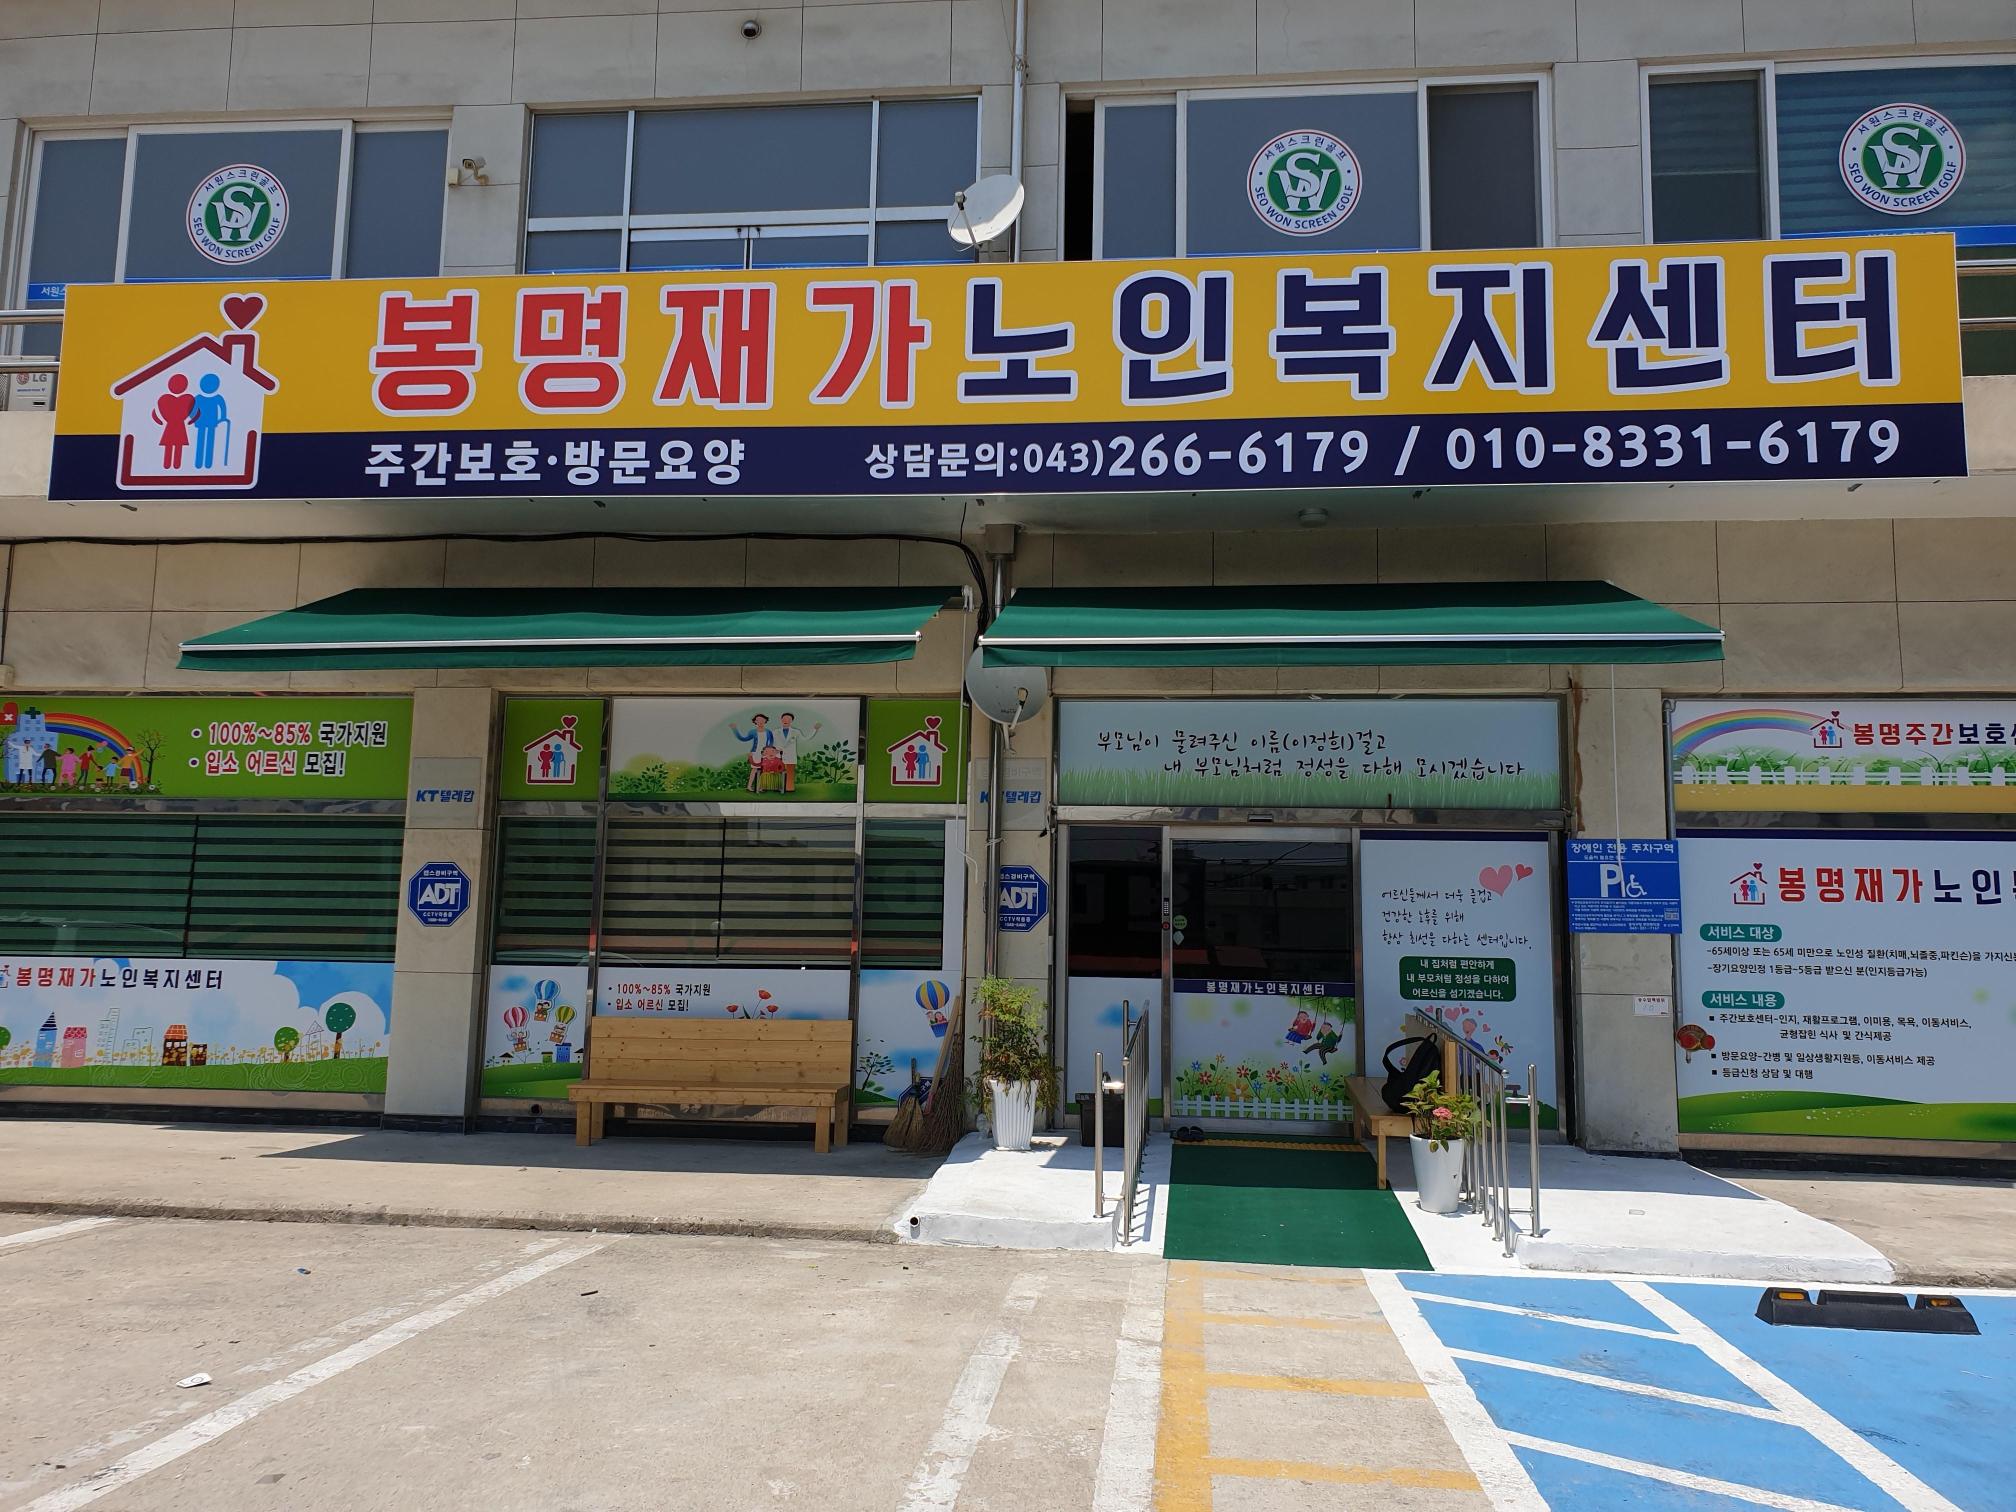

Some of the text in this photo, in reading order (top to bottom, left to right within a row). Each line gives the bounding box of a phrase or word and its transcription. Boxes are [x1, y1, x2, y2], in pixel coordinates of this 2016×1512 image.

[1857, 108, 1949, 137] 서원스크린골프
[1265, 135, 1348, 161] 서원스크린골프
[204, 169, 279, 195] 서원스크린골프
[1848, 161, 1957, 207] SEO WON SCREEN GOLF
[1255, 184, 1354, 229] SEO WON SCREEN GOLF
[193, 217, 280, 258] SEO WON SCREEN GOLF
[369, 249, 1901, 418] 봉명재가노인복지센터
[32, 373, 48, 383] LG
[1445, 418, 1901, 469] 010-8331-6179
[364, 437, 745, 488] 주간보호·방문요양
[208, 721, 388, 747] 100%~85% 국가지원
[1097, 731, 1159, 752] 부모님이
[1171, 729, 1237, 754] 물려주신
[1853, 722, 2016, 746] 봉명주간보호
[206, 750, 346, 777] 입소 어르신 모집!
[1164, 756, 1525, 780] 내 부모님처럼 정성을 다해 모시겠습니다
[1571, 843, 1603, 854] 장애인
[1631, 843, 1674, 854] 주차구역
[1600, 863, 1623, 897] P
[1778, 866, 2016, 904] 봉명재가노인
[419, 882, 461, 905] ADT
[1000, 886, 1038, 909] ADT
[1381, 887, 1493, 904] 어르신들께서 더욱 즐겁고
[1382, 908, 1465, 926] 건강한 노후를 위해
[1382, 929, 1532, 950] 항상 최선을 다하는 센터입니다.
[1708, 925, 1775, 940] 서비스 대상
[1753, 947, 1771, 957] 또는
[1773, 947, 1794, 957] 65세
[1797, 947, 1833, 958] 미만으로
[1836, 948, 1864, 959] 노인성
[1420, 960, 1495, 970] 내 집처럼 편안하게
[1825, 965, 1853, 976] 받으신
[1855, 966, 1928, 978] 분(인지등급가능)
[16, 966, 223, 990] 봉명재가노인복지센터
[617, 983, 711, 996] 100%~85% 국가지원
[1206, 981, 1325, 996] 봉명재가노인복지센터
[1406, 973, 1510, 985] 내 부모처럼 정성을 다하여
[615, 998, 689, 1011] 입소 어르신 모집!
[1412, 988, 1447, 998] 어르신을
[1710, 993, 1777, 1007] 서비스 내용
[1779, 1029, 1892, 1041] 균형잡힌 식사 및 간식제공
[1721, 1051, 1781, 1062] 방문요양-간병
[1784, 1052, 1793, 1062] 및
[1866, 1054, 1914, 1065] 이동서비스
[1916, 1056, 1936, 1066] 제공
[1722, 1067, 1814, 1080] 등급신청 상담 및 대행
